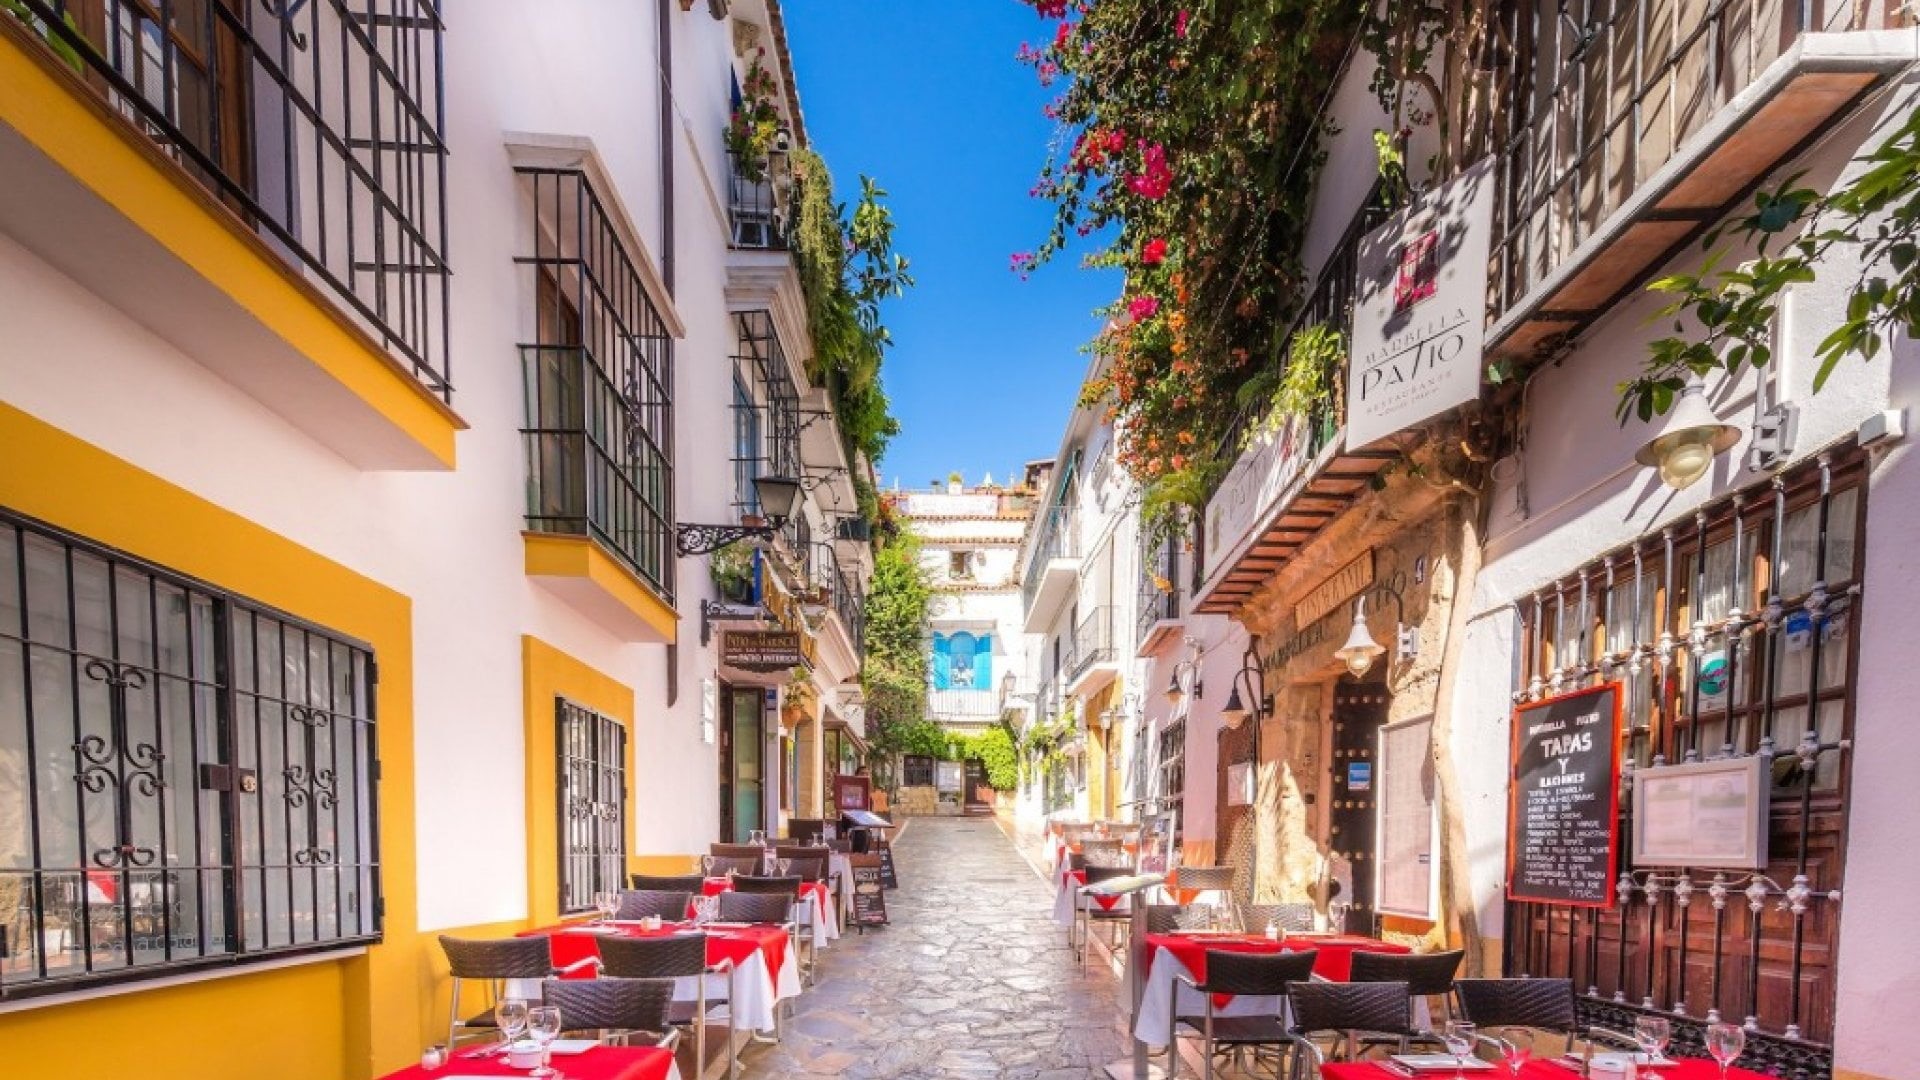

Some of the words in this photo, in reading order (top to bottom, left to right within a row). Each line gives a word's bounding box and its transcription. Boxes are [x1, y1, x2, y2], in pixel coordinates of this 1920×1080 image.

[1366, 308, 1465, 364] MARBELLA
[1360, 321, 1469, 401] PATIO
[1541, 731, 1592, 757] TAPAS
[1558, 757, 1570, 774] Y
